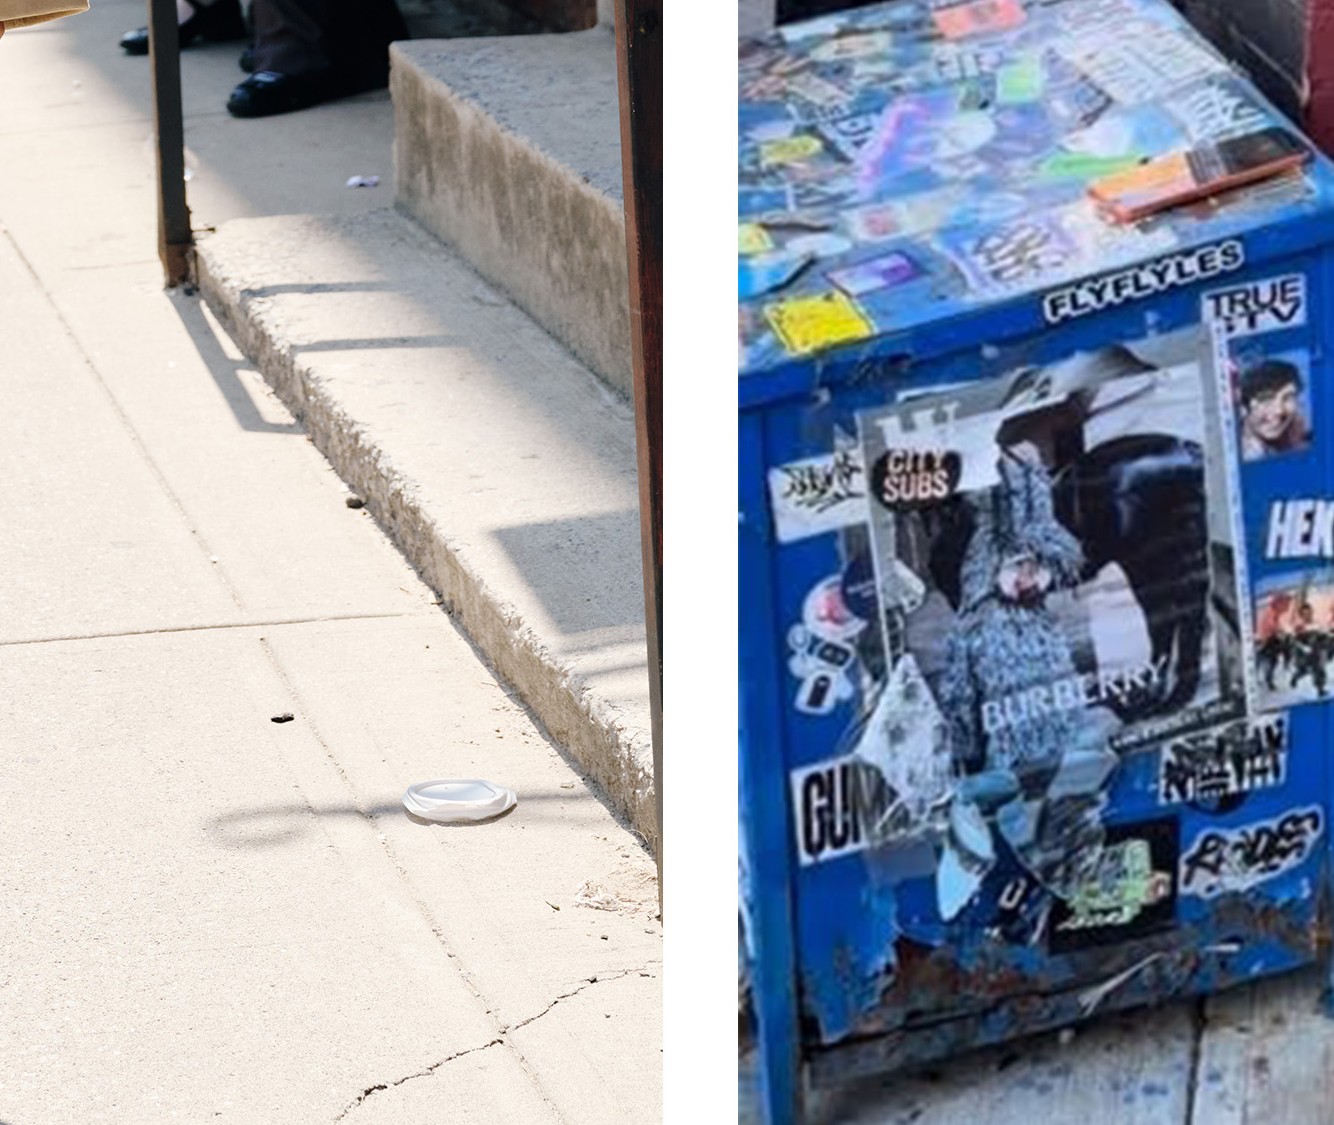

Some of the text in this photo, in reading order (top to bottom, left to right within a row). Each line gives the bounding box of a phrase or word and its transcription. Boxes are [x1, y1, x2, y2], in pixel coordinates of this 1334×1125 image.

[1207, 277, 1301, 318] TRUE
[887, 446, 945, 474] CITY
[883, 469, 950, 503] SUBS
[982, 655, 1167, 733] BURBERRY
